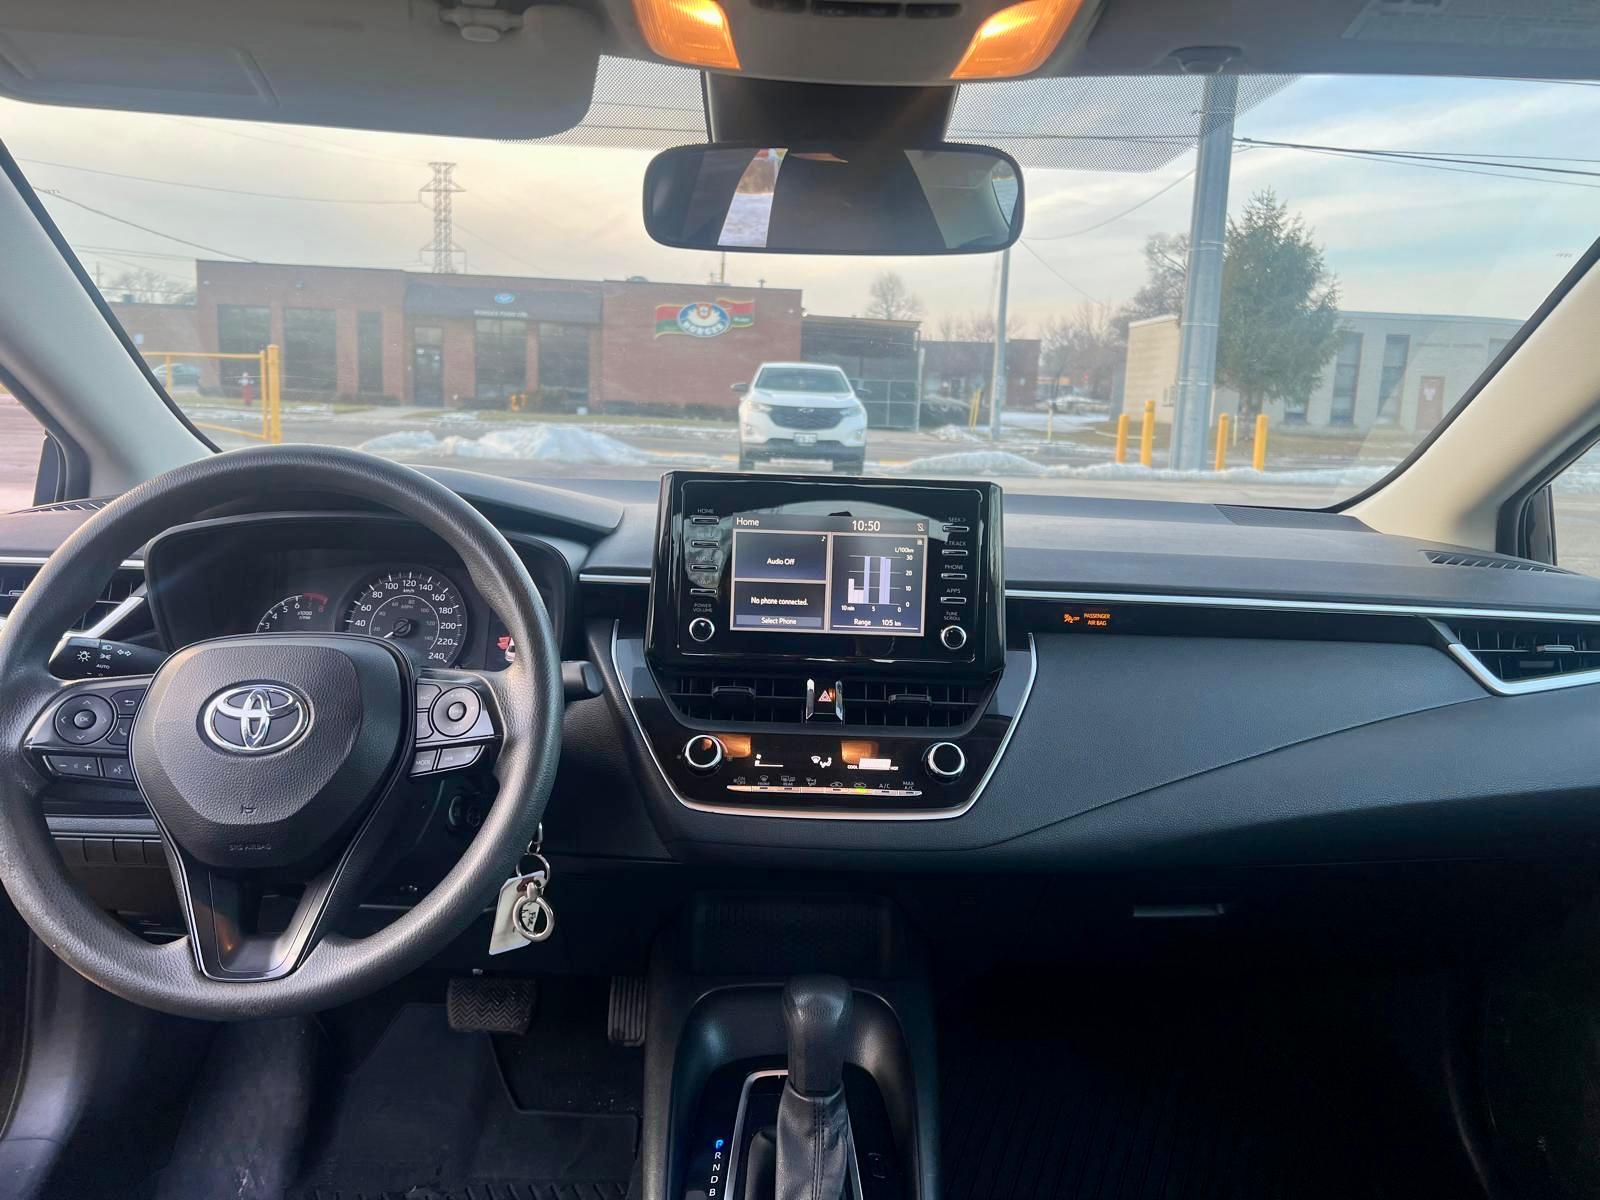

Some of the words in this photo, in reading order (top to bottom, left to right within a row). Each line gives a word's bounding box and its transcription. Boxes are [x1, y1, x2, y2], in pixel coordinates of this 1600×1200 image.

[736, 517, 760, 526] Home
[852, 520, 881, 532] 10:50
[767, 557, 784, 565] Audio
[750, 596, 760, 604] No
[760, 597, 778, 605] phone
[778, 598, 808, 606] connected.
[264, 622, 270, 630] 3
[440, 622, 456, 630] 200
[853, 618, 872, 627] Range
[437, 638, 453, 646] 220
[428, 652, 444, 660] 240
[715, 1139, 724, 1149] P
[714, 1151, 721, 1160] R
[712, 1163, 720, 1171] N
[710, 1175, 719, 1184] D
[708, 1188, 716, 1197] B
